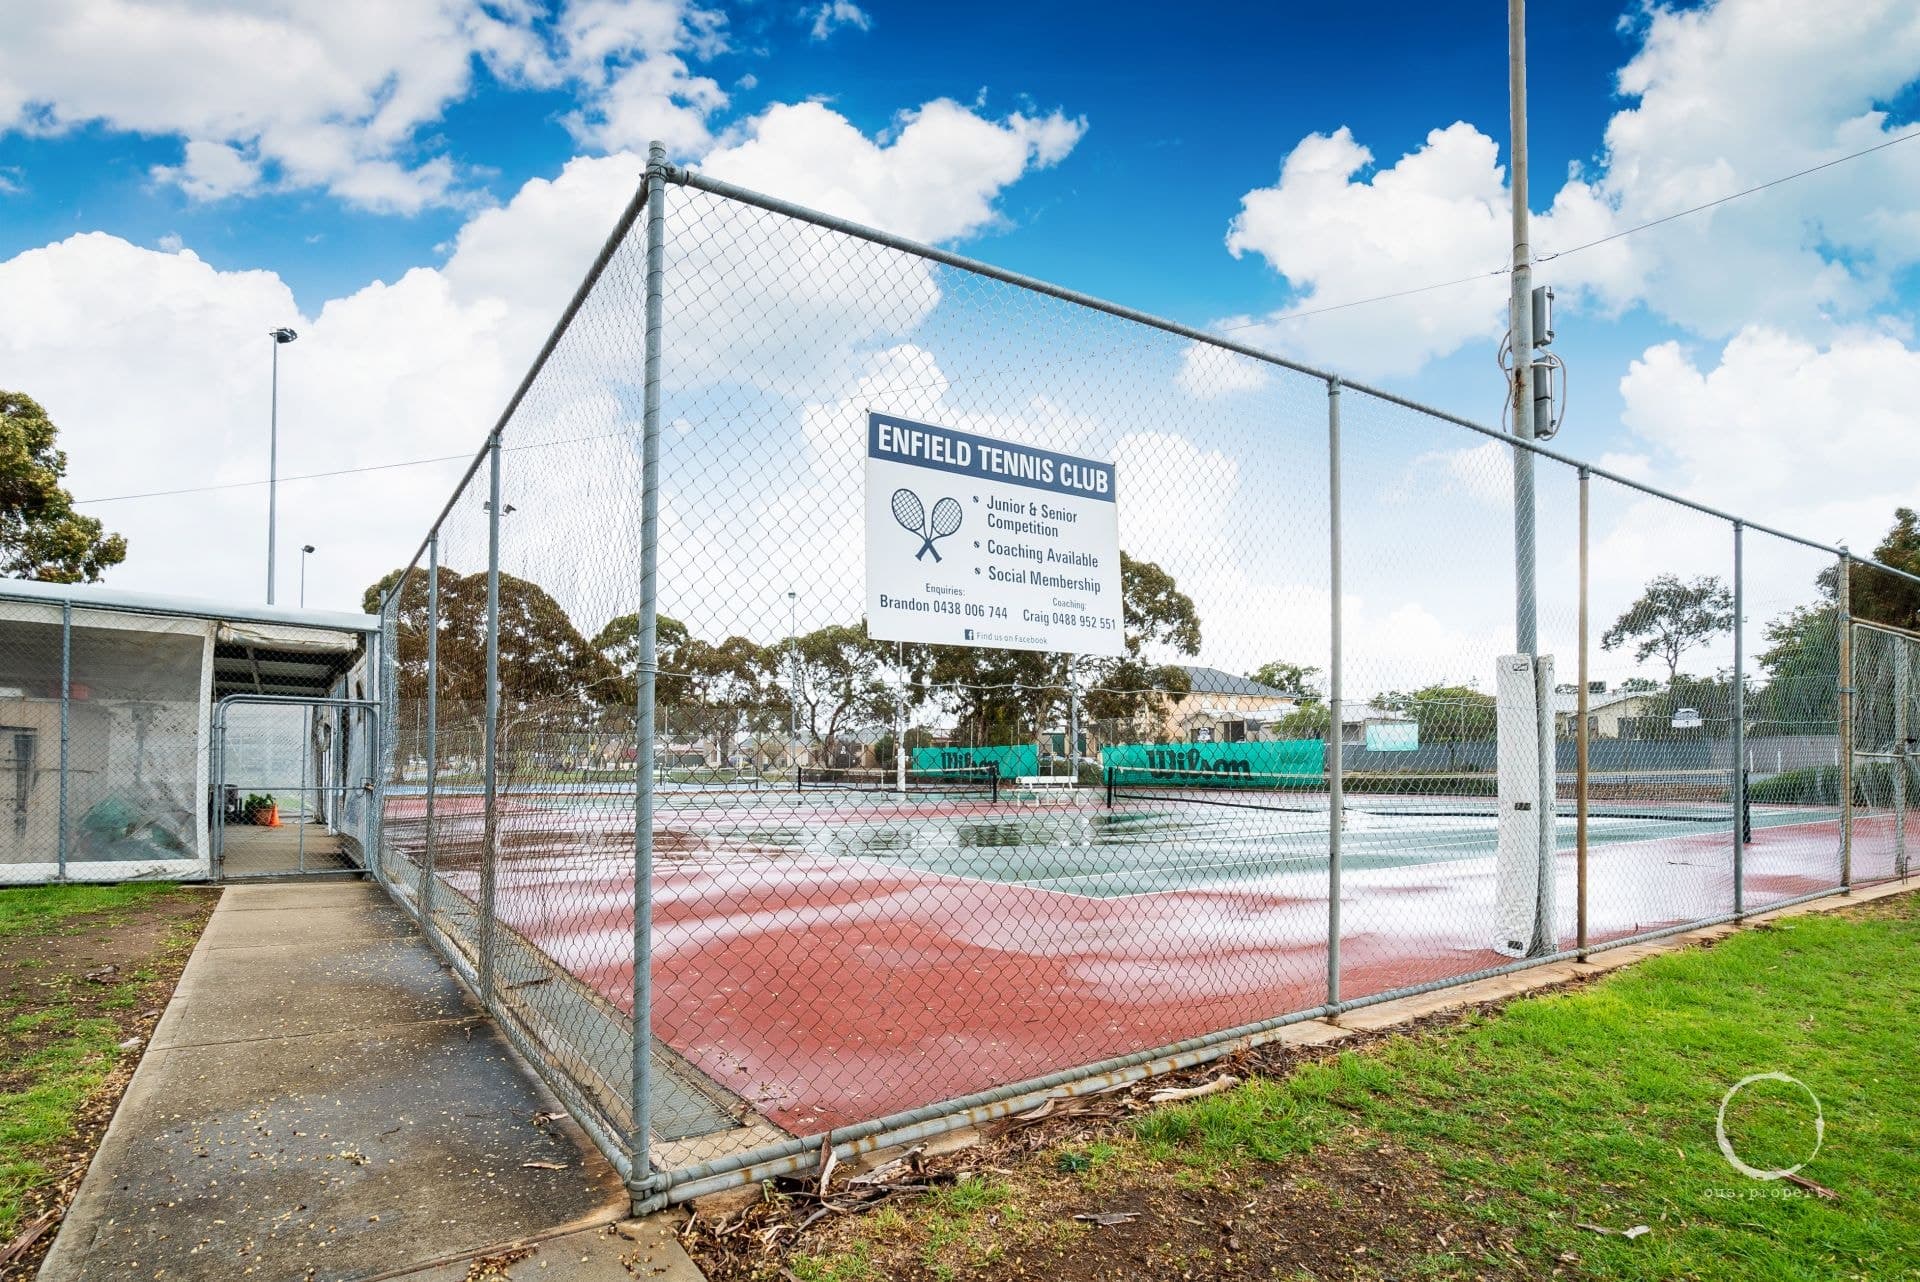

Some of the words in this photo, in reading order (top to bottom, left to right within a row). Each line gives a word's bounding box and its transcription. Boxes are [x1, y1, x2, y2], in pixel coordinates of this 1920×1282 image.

[878, 423, 972, 467] ENFIELD
[977, 445, 1054, 483] TENNIS
[1060, 463, 1109, 494] CLUB
[987, 495, 1026, 515] Junior
[1029, 502, 1037, 516] &
[1041, 504, 1078, 523] Senior
[987, 513, 1059, 538] Competition
[987, 539, 1043, 564] Coaching
[1047, 548, 1099, 568] Available
[925, 583, 966, 597] Enquiries:
[988, 565, 1026, 584] Social
[1030, 570, 1101, 595] Membership
[880, 594, 930, 612] Brandon
[933, 600, 961, 615] 0438
[964, 603, 985, 617] 006
[988, 605, 1008, 619] 744
[1023, 609, 1049, 626] Craig
[1052, 612, 1077, 626] 0488
[1079, 616, 1097, 628] 952
[1100, 617, 1116, 630] 551
[976, 631, 993, 641] Find
[1015, 634, 1047, 645] Facebook
[941, 751, 1000, 776] Wilson
[1146, 748, 1253, 781] Wilson
